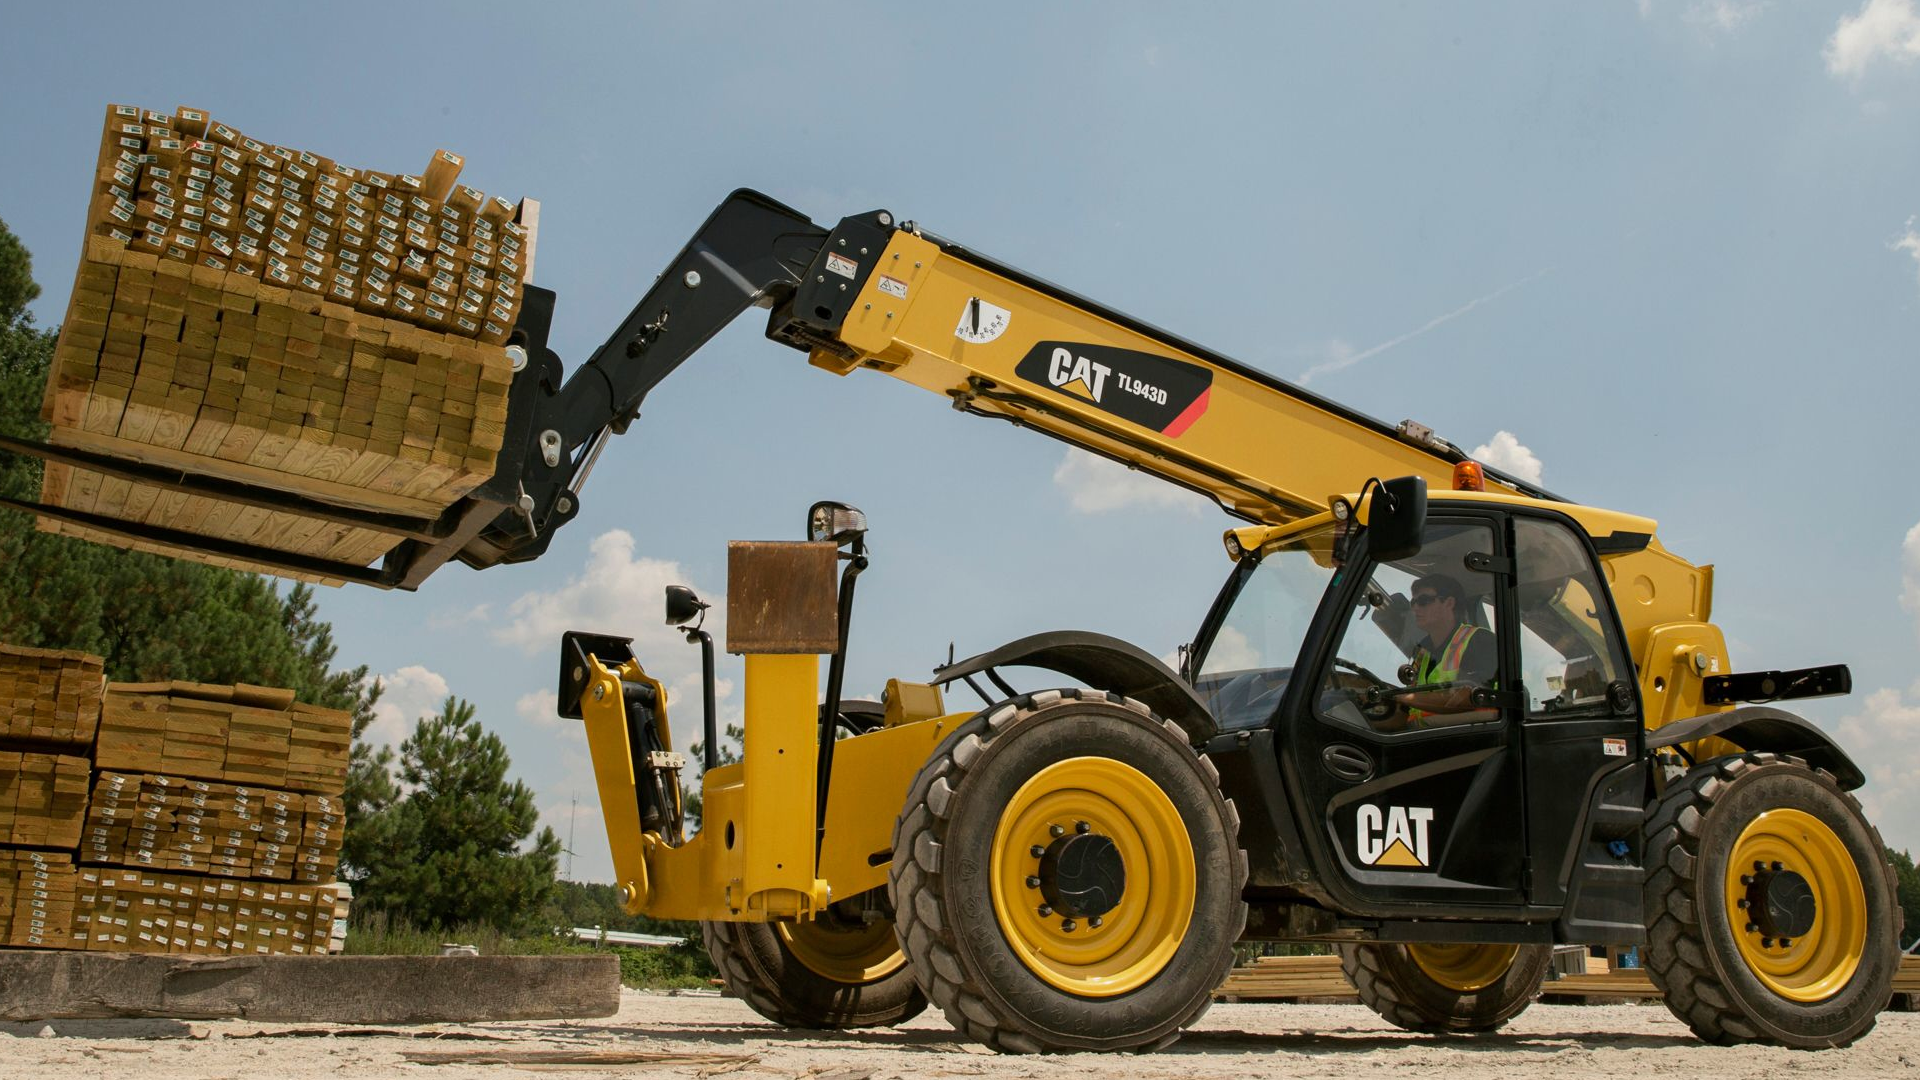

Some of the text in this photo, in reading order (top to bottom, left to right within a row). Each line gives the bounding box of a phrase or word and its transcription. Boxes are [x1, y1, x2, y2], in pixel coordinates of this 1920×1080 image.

[1048, 347, 1168, 406] CAT TL943D
[1357, 804, 1434, 867] CAT
